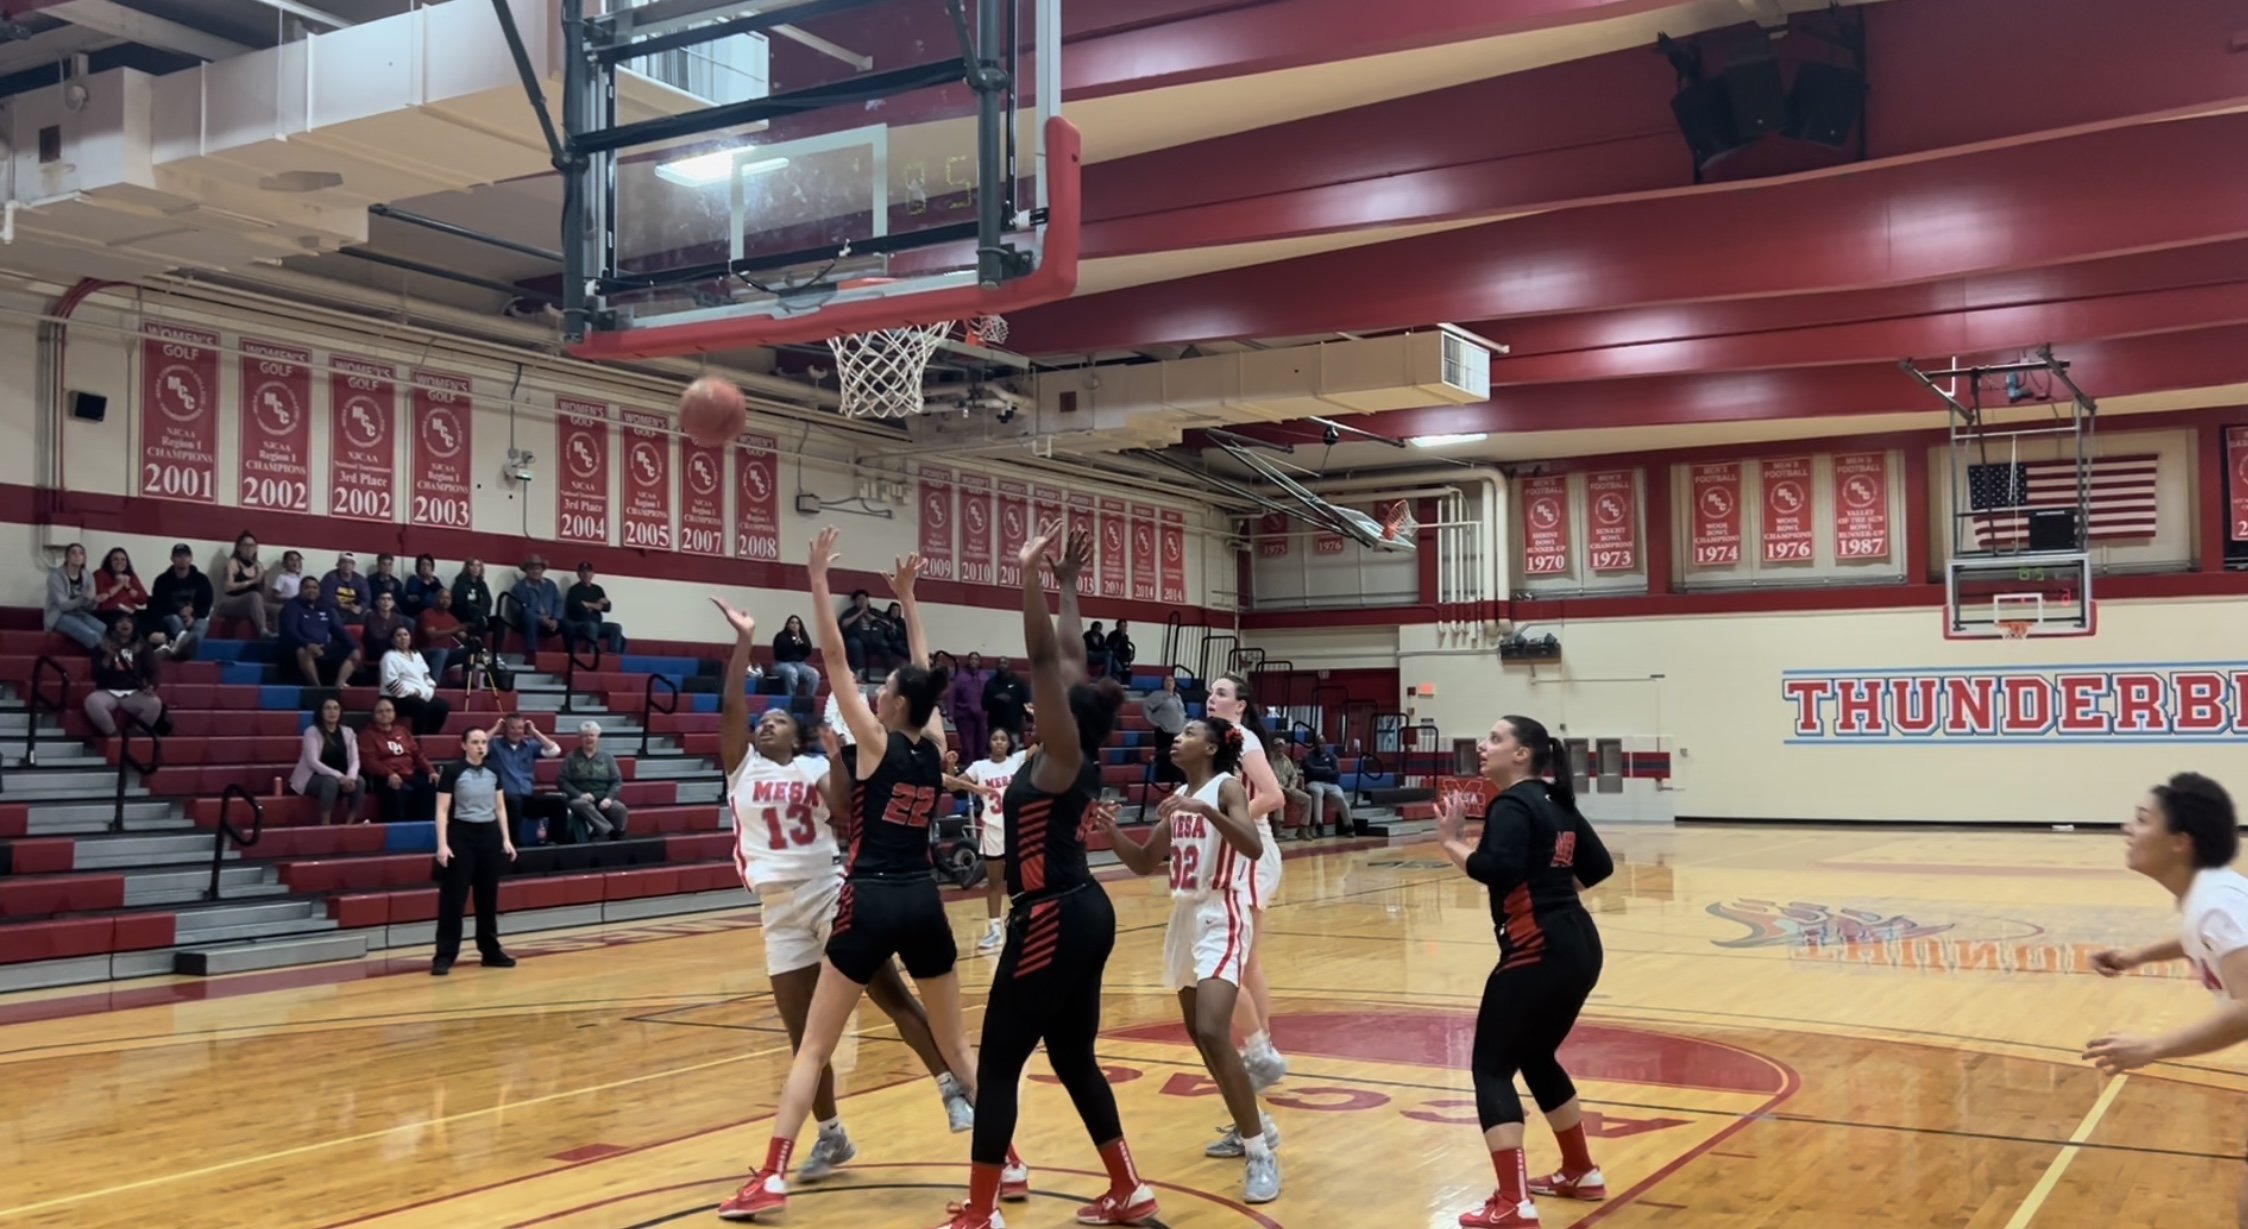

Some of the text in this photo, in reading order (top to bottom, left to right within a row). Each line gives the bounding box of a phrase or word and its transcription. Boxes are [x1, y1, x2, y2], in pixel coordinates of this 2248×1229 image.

[163, 344, 199, 360] GOLF
[259, 361, 293, 377] GOLF
[348, 376, 379, 391] GOLF
[427, 389, 456, 404] GOLF
[147, 446, 213, 463] CHAMPIONS
[245, 460, 307, 475] CHAMPIONS
[1764, 468, 1809, 479] FOOTBALL
[1837, 464, 1881, 474] FOOTBALL
[144, 463, 213, 498] 2001
[339, 470, 388, 487] 3rd Place
[1590, 481, 1629, 490] FOOTBALL
[1695, 474, 1737, 484] FOOTBALL
[243, 476, 307, 509] 2002
[416, 480, 469, 494] CHAMPIONS
[1526, 487, 1564, 496] FOOTBALL
[333, 486, 391, 518] 2002
[563, 498, 603, 513] 3rd Place
[414, 495, 469, 526] 2003
[1846, 509, 1875, 517] VALLEY
[561, 513, 606, 540] 2004
[1776, 524, 1799, 532] BOWL
[1838, 517, 1849, 525] OF
[1867, 515, 1884, 523] SUN
[1849, 523, 1874, 531] BOWL
[624, 521, 670, 547] 2005
[682, 527, 722, 553] 2007
[1601, 534, 1621, 542] BOWL
[1694, 535, 1740, 544] CHAMPIONS
[1706, 528, 1729, 536] BOWL
[1763, 531, 1812, 540] CHAMPIONS
[1838, 530, 1885, 538] RUNNER-UP
[740, 534, 776, 558] 2008
[1589, 541, 1633, 550] CHAMPIONS
[1697, 545, 1739, 562] 1974
[1767, 541, 1811, 559] 1976
[1839, 538, 1884, 555] 1987
[1527, 554, 1565, 571] 1970
[1592, 550, 1631, 567] 1973
[922, 557, 951, 578] 2009
[962, 562, 991, 582] 2010
[1001, 565, 1021, 586] 201
[752, 780, 819, 807] MESA
[881, 782, 936, 828] 22
[761, 804, 818, 851] 13
[1170, 845, 1199, 890] 32
